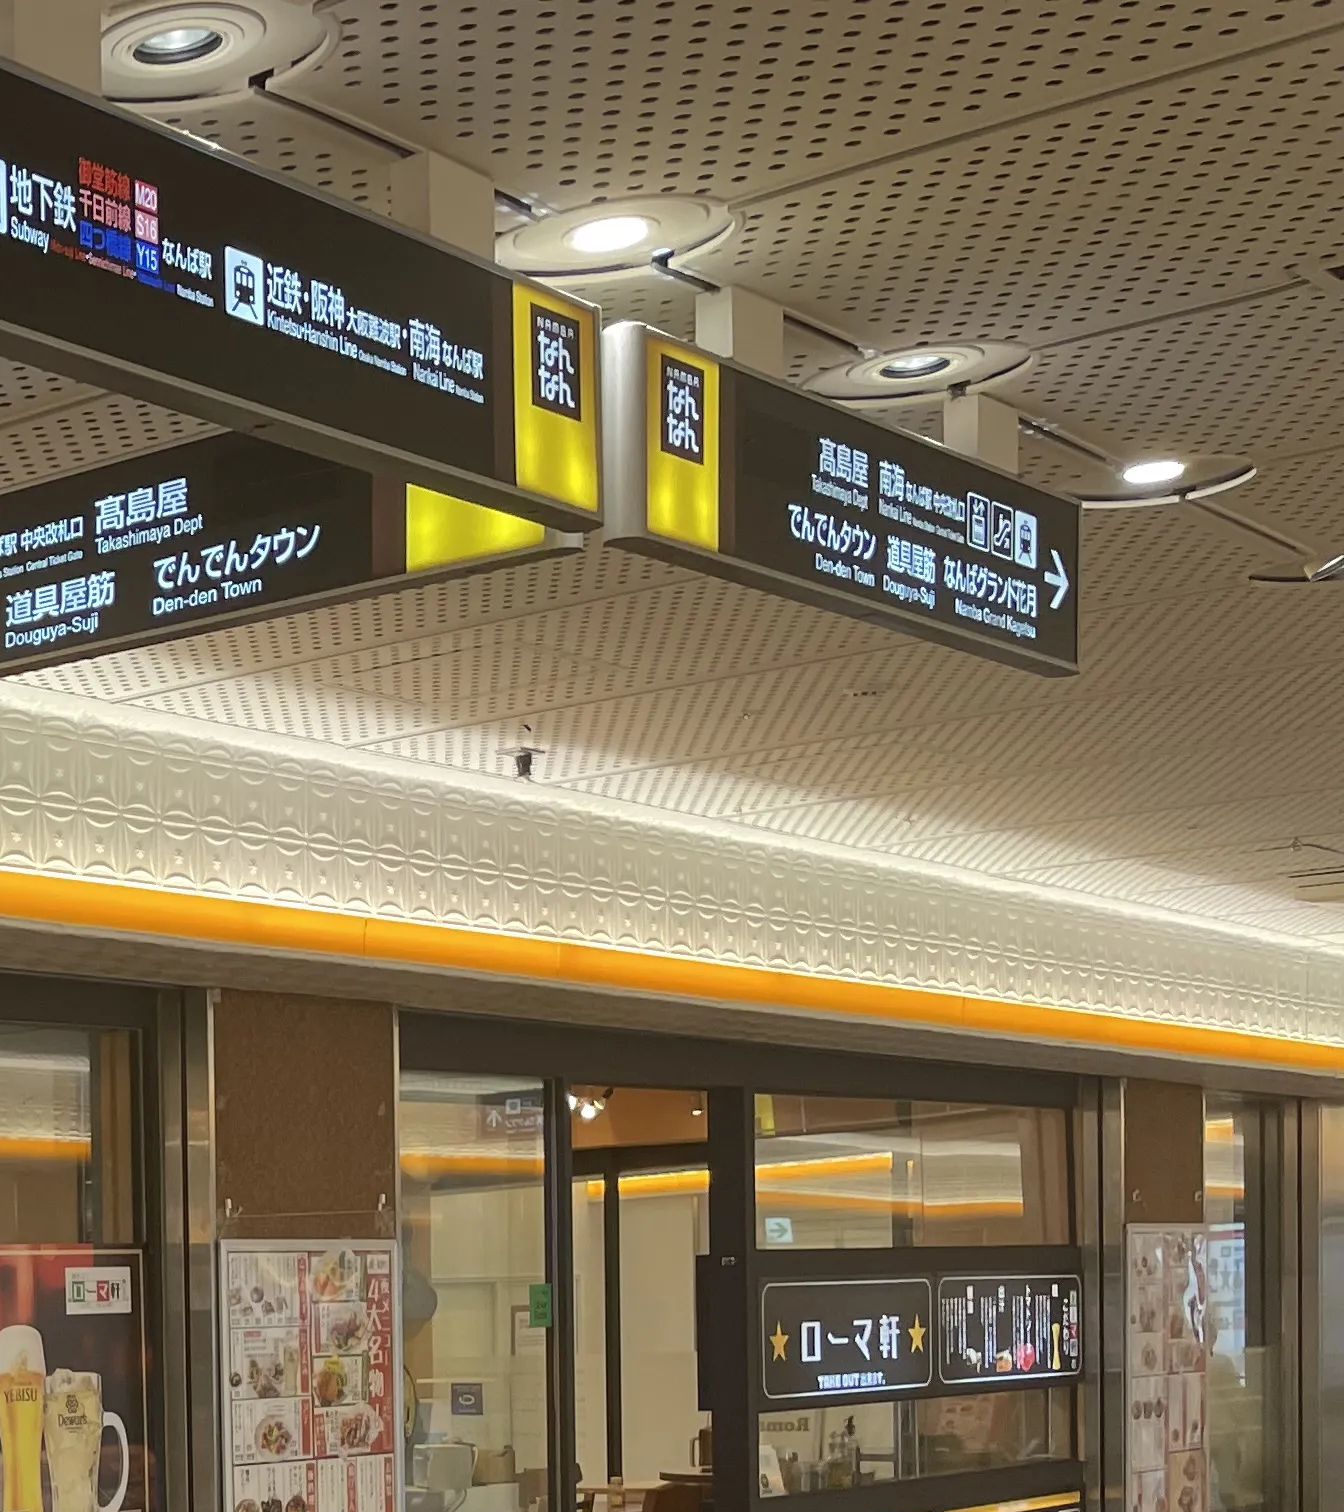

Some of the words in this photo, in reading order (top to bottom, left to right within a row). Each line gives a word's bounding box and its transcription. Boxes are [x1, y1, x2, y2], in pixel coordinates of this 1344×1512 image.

[9, 164, 76, 232] 地下鉄
[79, 188, 131, 232] 千日前線
[135, 182, 158, 210] M20
[10, 215, 50, 254] Subway
[135, 213, 158, 241] S16
[136, 242, 158, 272] Y15
[162, 237, 212, 280] なんば駅
[536, 316, 575, 340] NAMBA
[339, 335, 358, 360] Line
[439, 372, 455, 395] Line
[409, 318, 441, 366] 南海
[442, 341, 484, 381] なんば駅
[666, 366, 700, 388] NAMBA
[879, 460, 906, 502] 南海
[20, 515, 84, 553] 中央改札口
[94, 523, 172, 555] Takashimaya
[174, 513, 204, 537] Dept
[4, 570, 116, 629] 道具屋筋
[152, 523, 321, 591] でんでんタウン
[787, 502, 877, 561] でんでんタウン
[886, 534, 937, 585] 道具屋筋
[943, 554, 1038, 619] なんばグランド花月
[815, 552, 852, 581] Den-den
[852, 564, 876, 588] Town
[954, 598, 982, 623] Namba
[982, 607, 1006, 629] Grand
[4, 611, 99, 650] Douguya-Suji
[152, 582, 217, 617] Den-den
[220, 576, 263, 600] Town
[800, 1314, 901, 1362] ローマ軒
[3, 1387, 38, 1403] YEBISU
[842, 1372, 859, 1387] OUT
